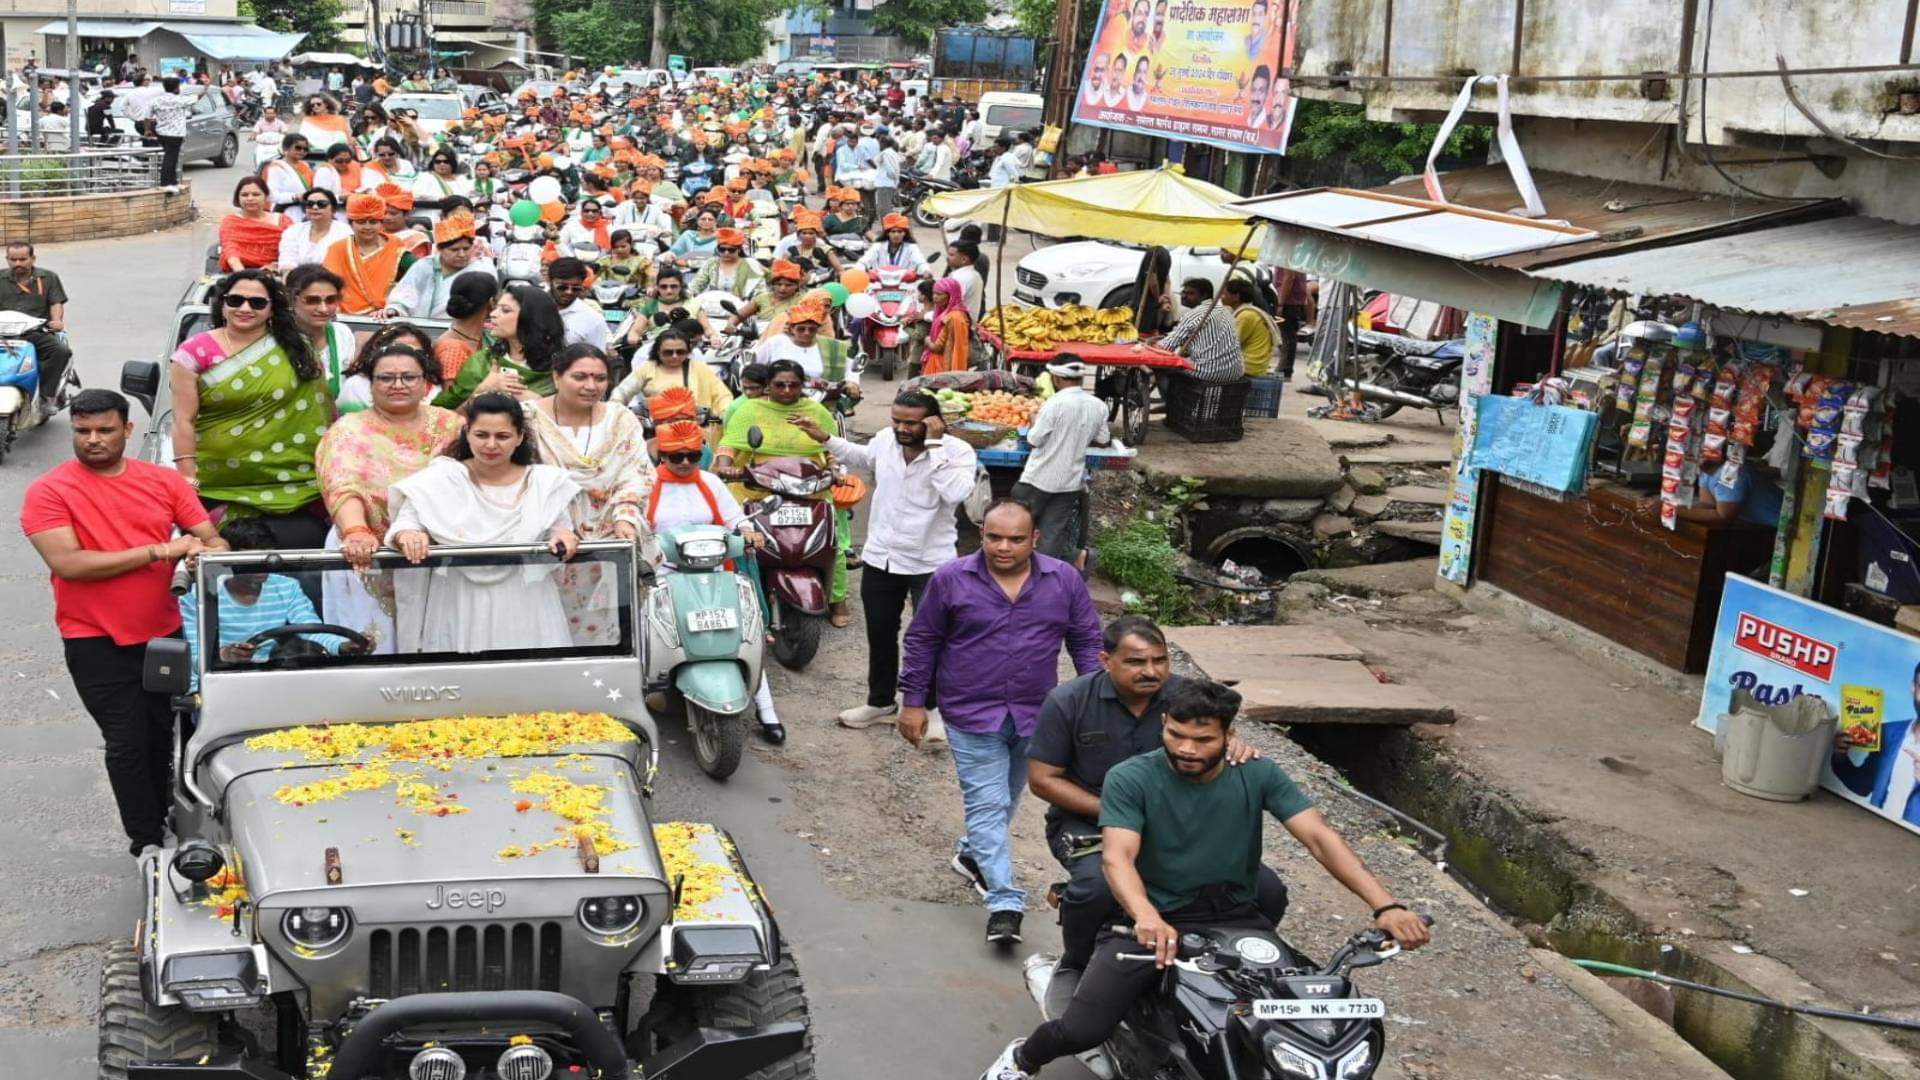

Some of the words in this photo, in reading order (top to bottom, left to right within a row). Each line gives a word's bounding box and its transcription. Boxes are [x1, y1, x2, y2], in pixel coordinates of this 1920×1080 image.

[1208, 7, 1250, 26] महासभा
[1741, 618, 1831, 667] PUSHP
[380, 685, 462, 703] WILLYS
[426, 884, 506, 914] Jeep
[1305, 984, 1332, 994] TVS
[1310, 1004, 1330, 1014] NK
[1347, 1003, 1378, 1014] 7730
